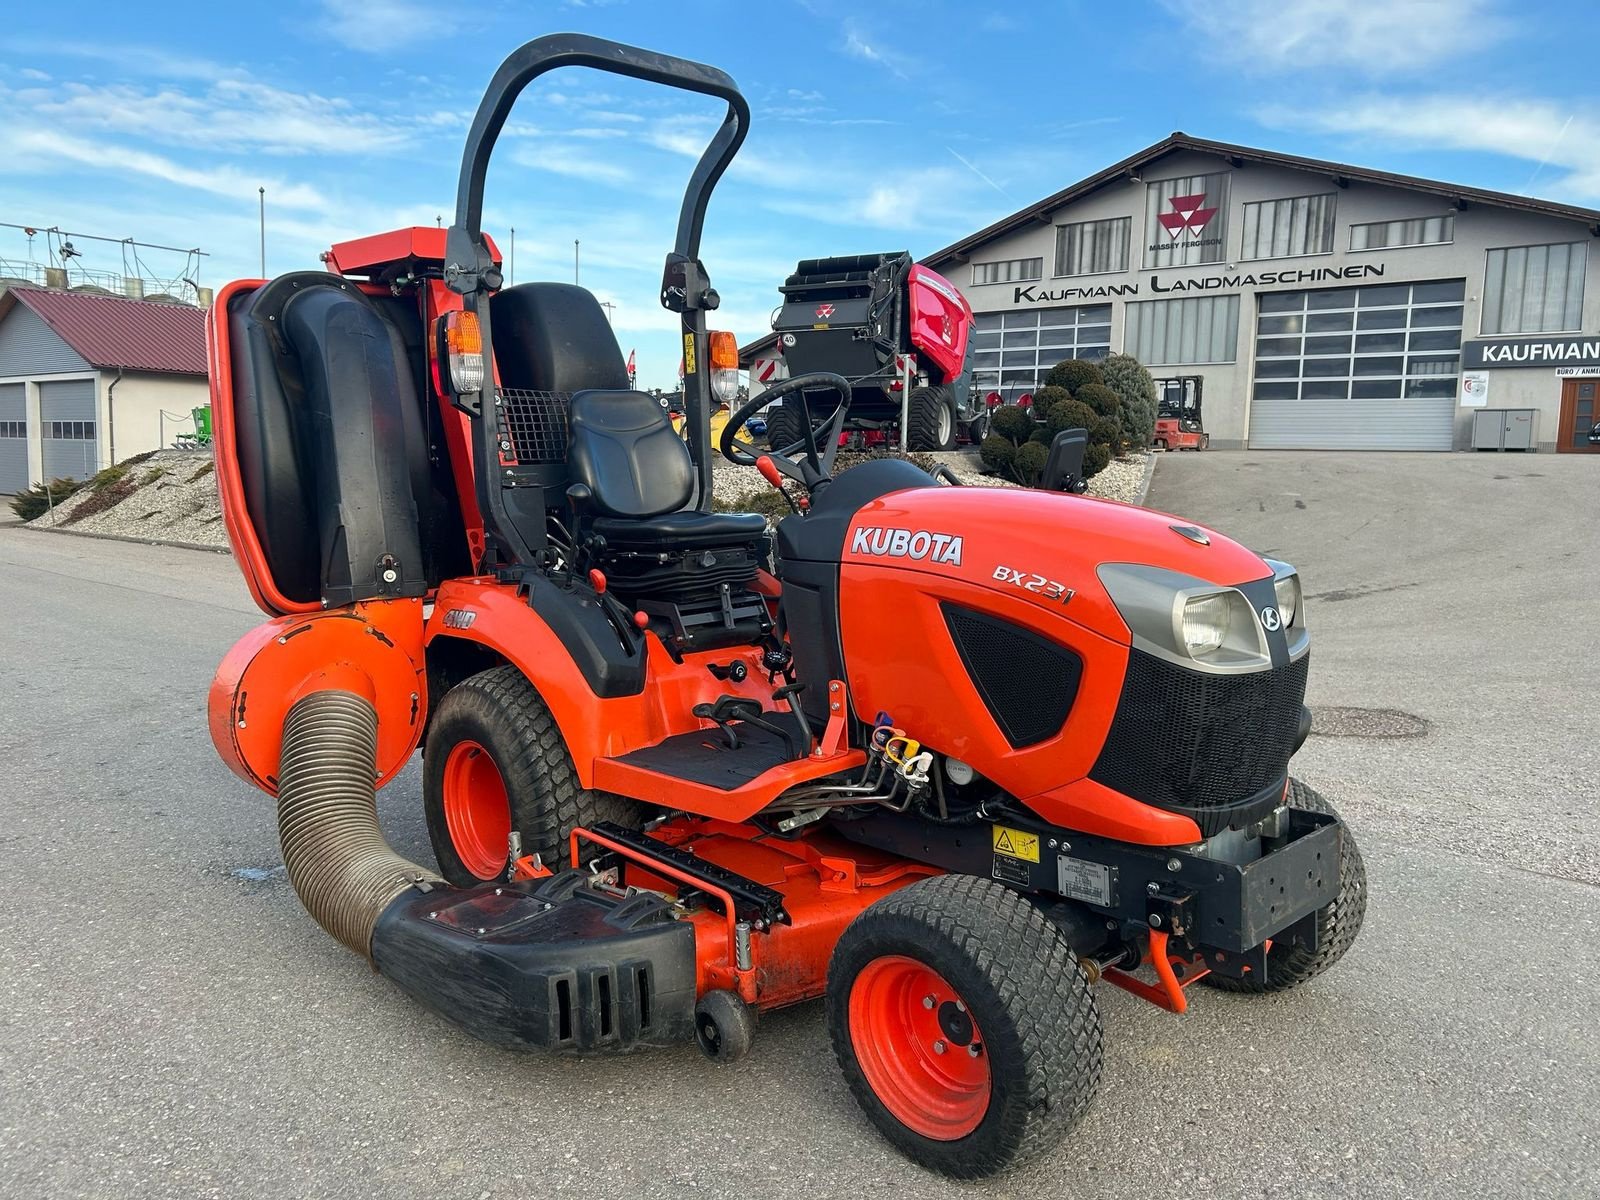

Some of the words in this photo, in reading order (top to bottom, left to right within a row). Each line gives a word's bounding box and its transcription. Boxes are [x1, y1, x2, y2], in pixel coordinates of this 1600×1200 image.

[1149, 242, 1180, 251] MASSEY
[1181, 238, 1222, 248] FERGUSON
[1482, 342, 1600, 361] KAUFMAN
[1557, 367, 1574, 375] BÜRO
[850, 527, 964, 567] KUBOTA
[992, 565, 1077, 606] BX231
[442, 609, 477, 630] 4WD
